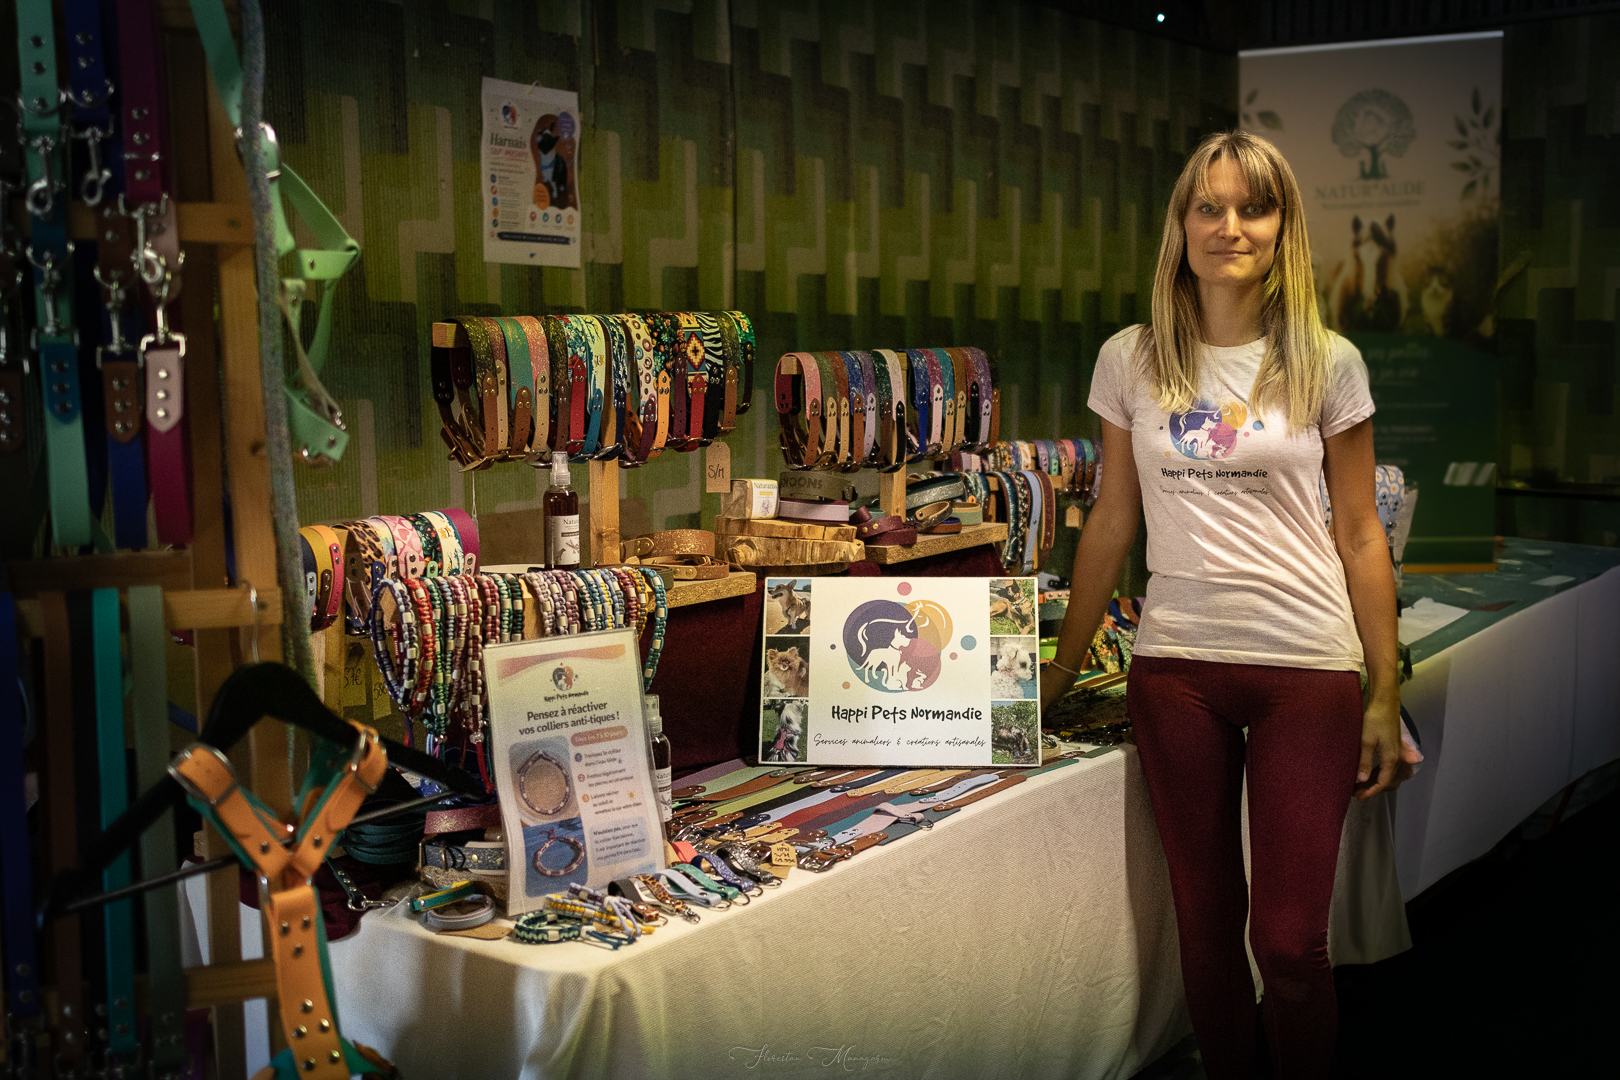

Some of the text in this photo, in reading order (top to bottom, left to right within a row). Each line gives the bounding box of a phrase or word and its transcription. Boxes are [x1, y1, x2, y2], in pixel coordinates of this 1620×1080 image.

[490, 132, 527, 149] Harnais
[1161, 467, 1268, 480] Happi Pets Normandie
[527, 701, 608, 721] Pensez à réactiver
[831, 705, 983, 724] Happi Pets Normandie
[519, 727, 535, 735] vos
[536, 722, 569, 733] colliers
[570, 713, 616, 727] anti-tiques
[813, 733, 848, 746] Services
[851, 735, 892, 746] animaliers
[944, 735, 986, 747] artisanales
